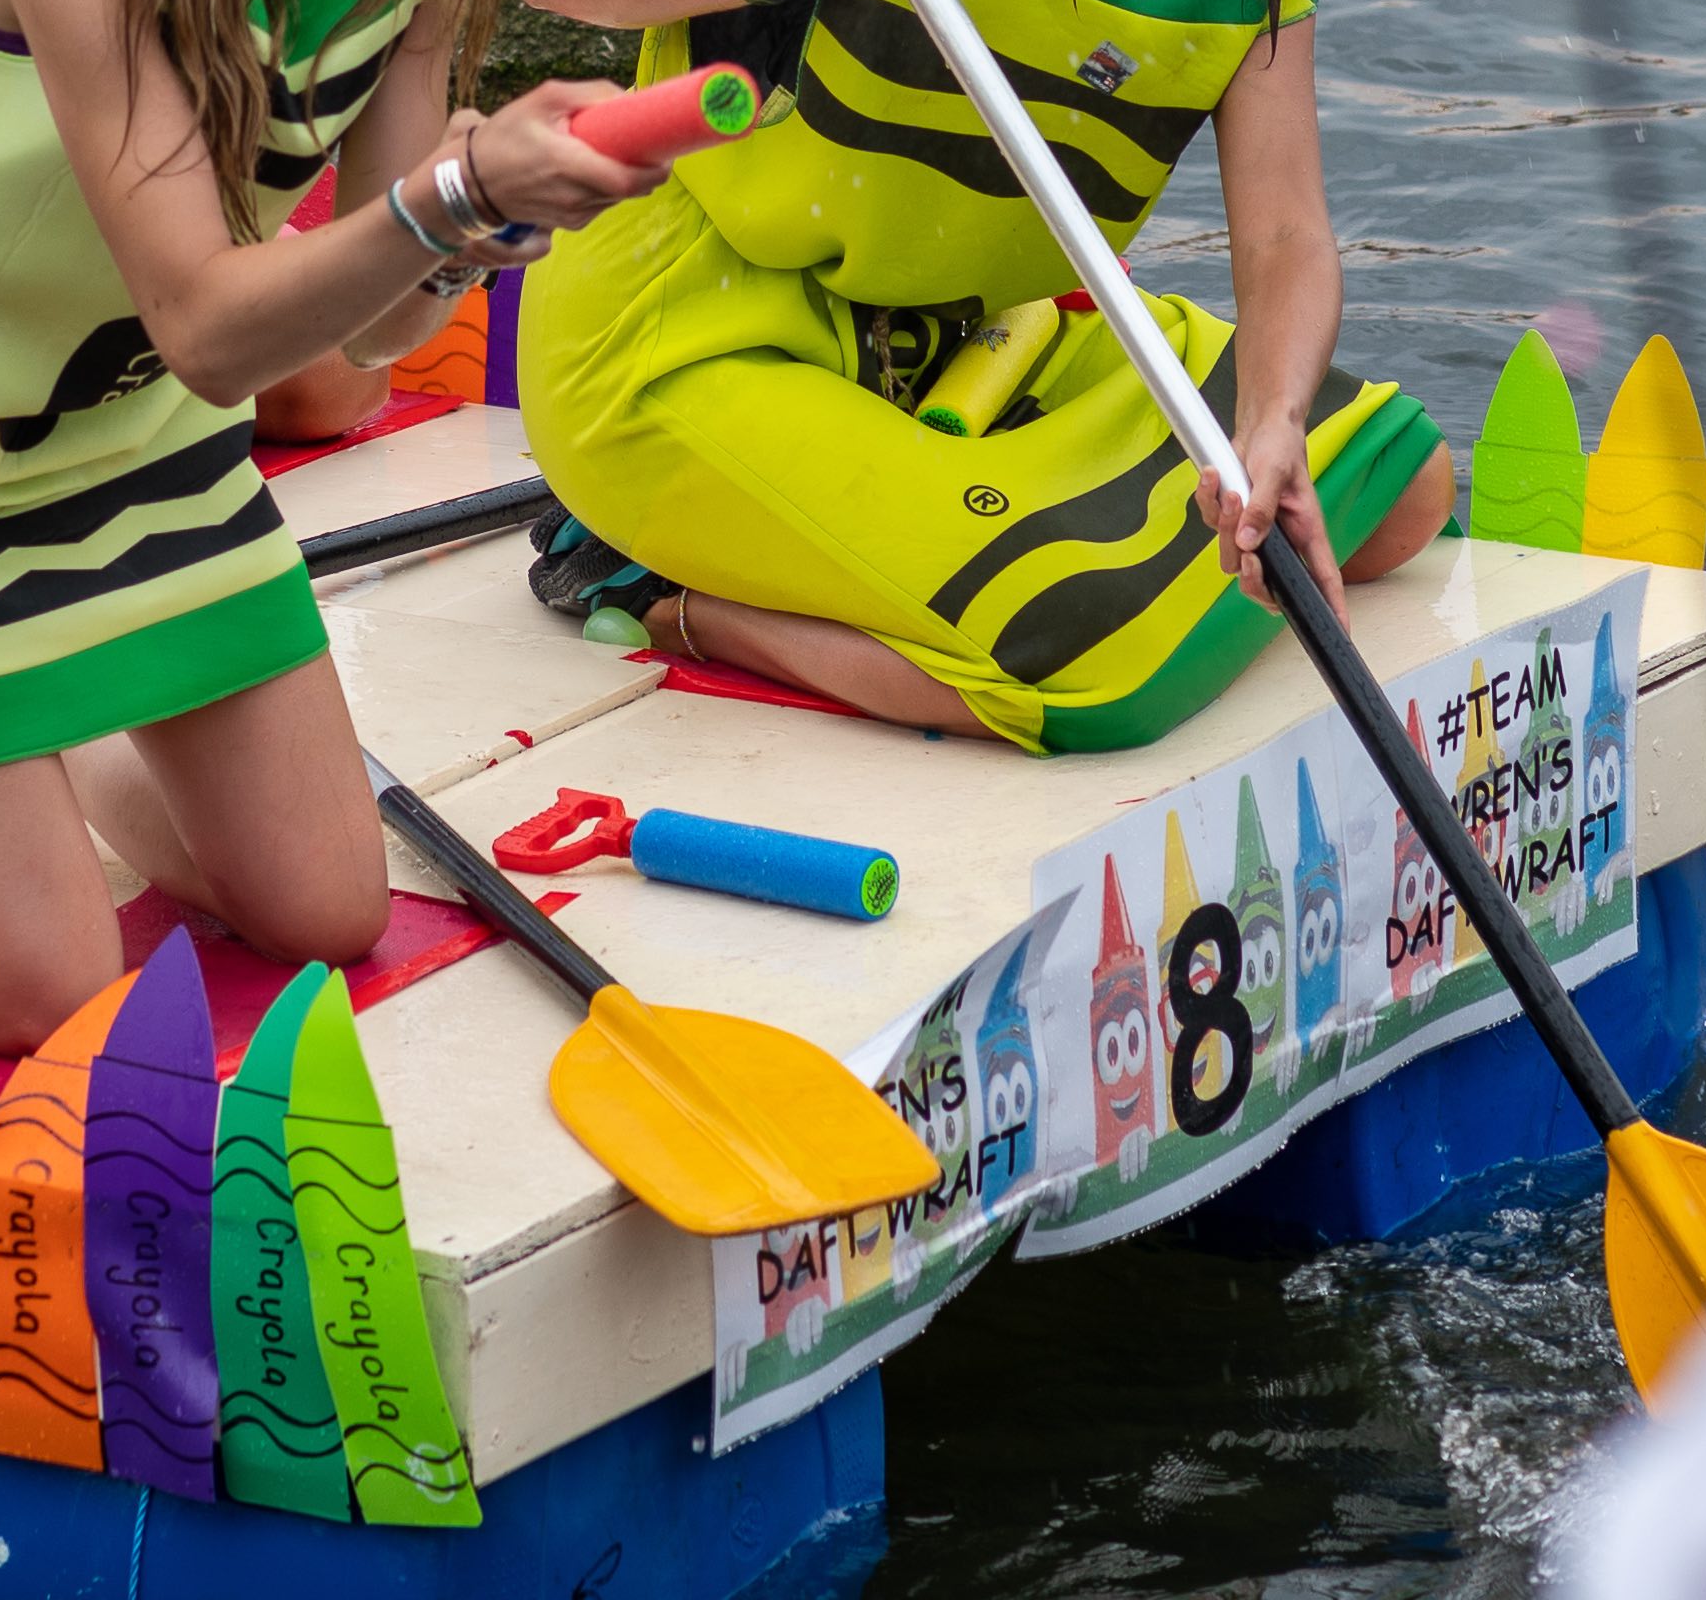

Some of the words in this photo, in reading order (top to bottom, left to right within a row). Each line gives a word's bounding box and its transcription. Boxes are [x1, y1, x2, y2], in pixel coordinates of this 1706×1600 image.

[1437, 647, 1567, 757] #TEAM
[1386, 889, 1471, 968] DAF
[1169, 903, 1254, 1137] 8
[105, 1190, 184, 1369] Crayola
[235, 1218, 298, 1387] Crayola
[324, 1243, 409, 1421] Crayola
